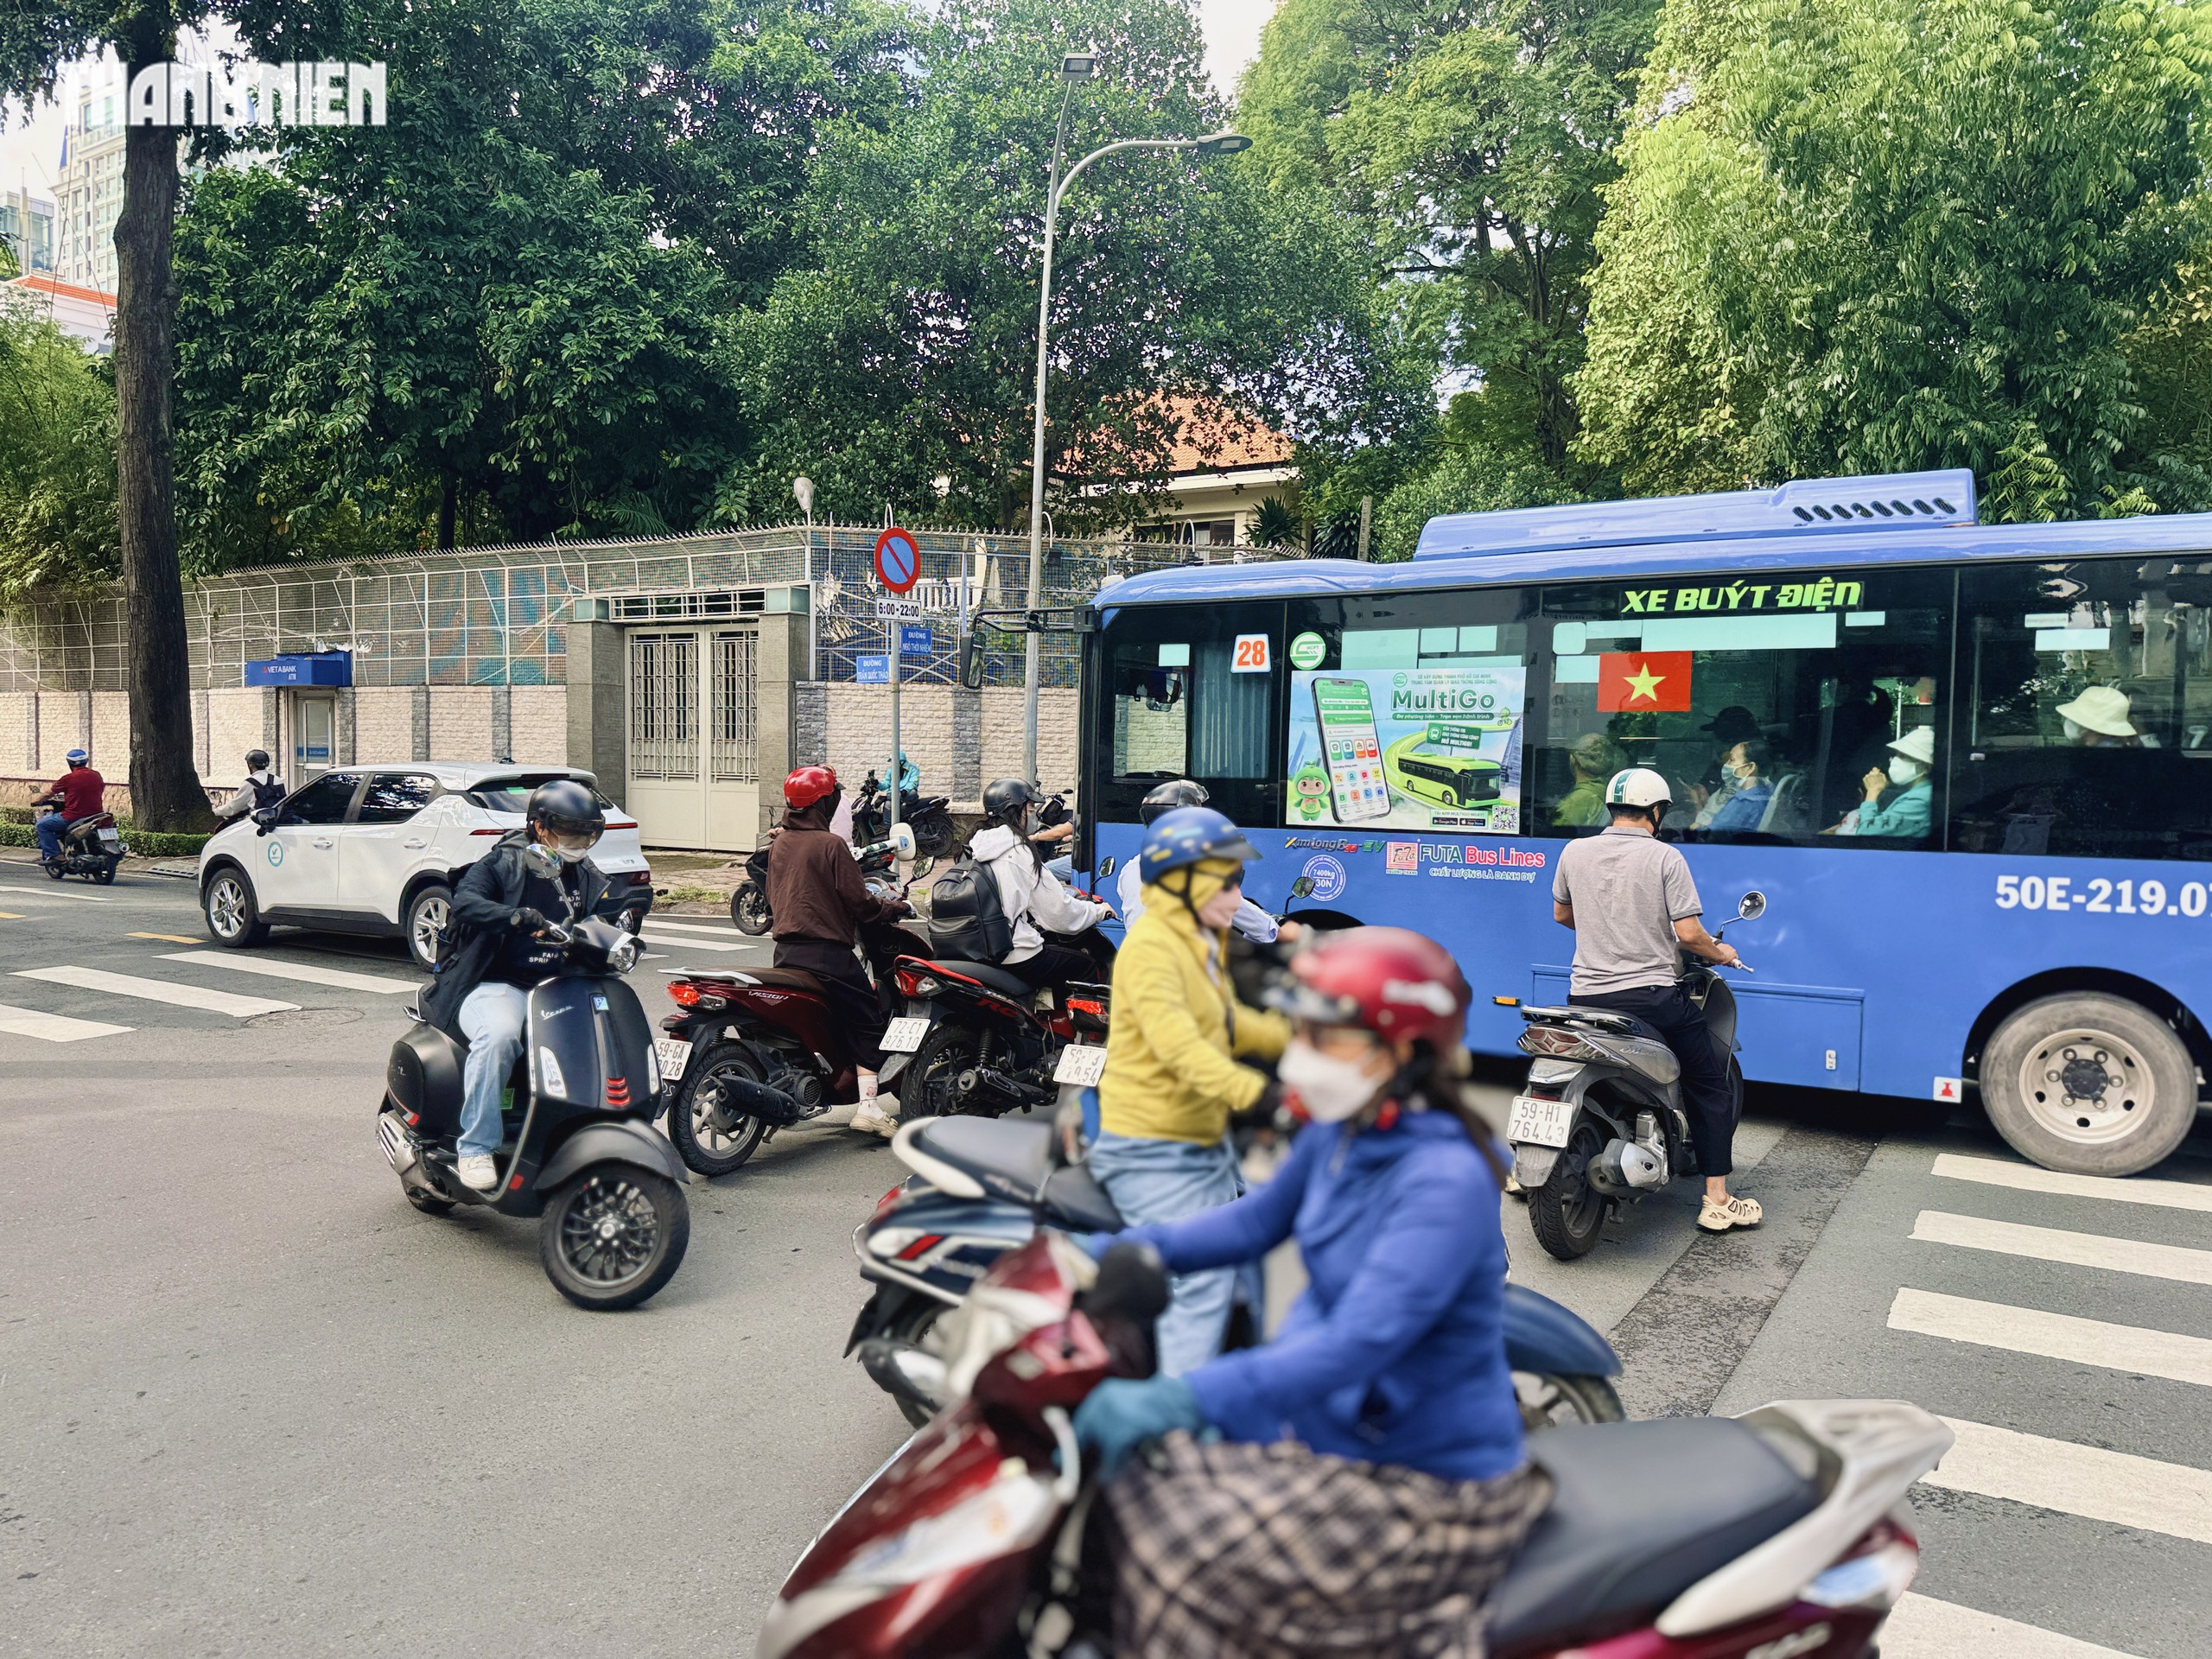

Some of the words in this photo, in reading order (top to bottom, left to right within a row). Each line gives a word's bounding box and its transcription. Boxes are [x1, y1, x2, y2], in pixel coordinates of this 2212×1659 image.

[1620, 589, 1668, 613] XE
[1674, 580, 1771, 612] BUÝT
[1776, 576, 1861, 612] ĐIỆN
[1236, 640, 1265, 666] 28
[1392, 689, 1495, 709] MultiGo
[1420, 844, 1463, 863] FUTA
[1465, 846, 1497, 865] Bus
[1499, 847, 1545, 868] Lines
[1313, 869, 1335, 878] 7400kg
[1429, 866, 1452, 877] CHẤT
[1452, 868, 1482, 880] LƯỢNG
[1483, 869, 1494, 879] LÀ
[1495, 871, 1520, 880] DANH
[1995, 874, 2212, 917] 50E-219.0
[748, 991, 789, 1000] VISION
[893, 1020, 922, 1034] 72-C1
[658, 1042, 685, 1059] 59-GA
[884, 1035, 919, 1049] 976.10
[1521, 1102, 1560, 1122] 59-H1
[1512, 1120, 1564, 1143] 764.43
